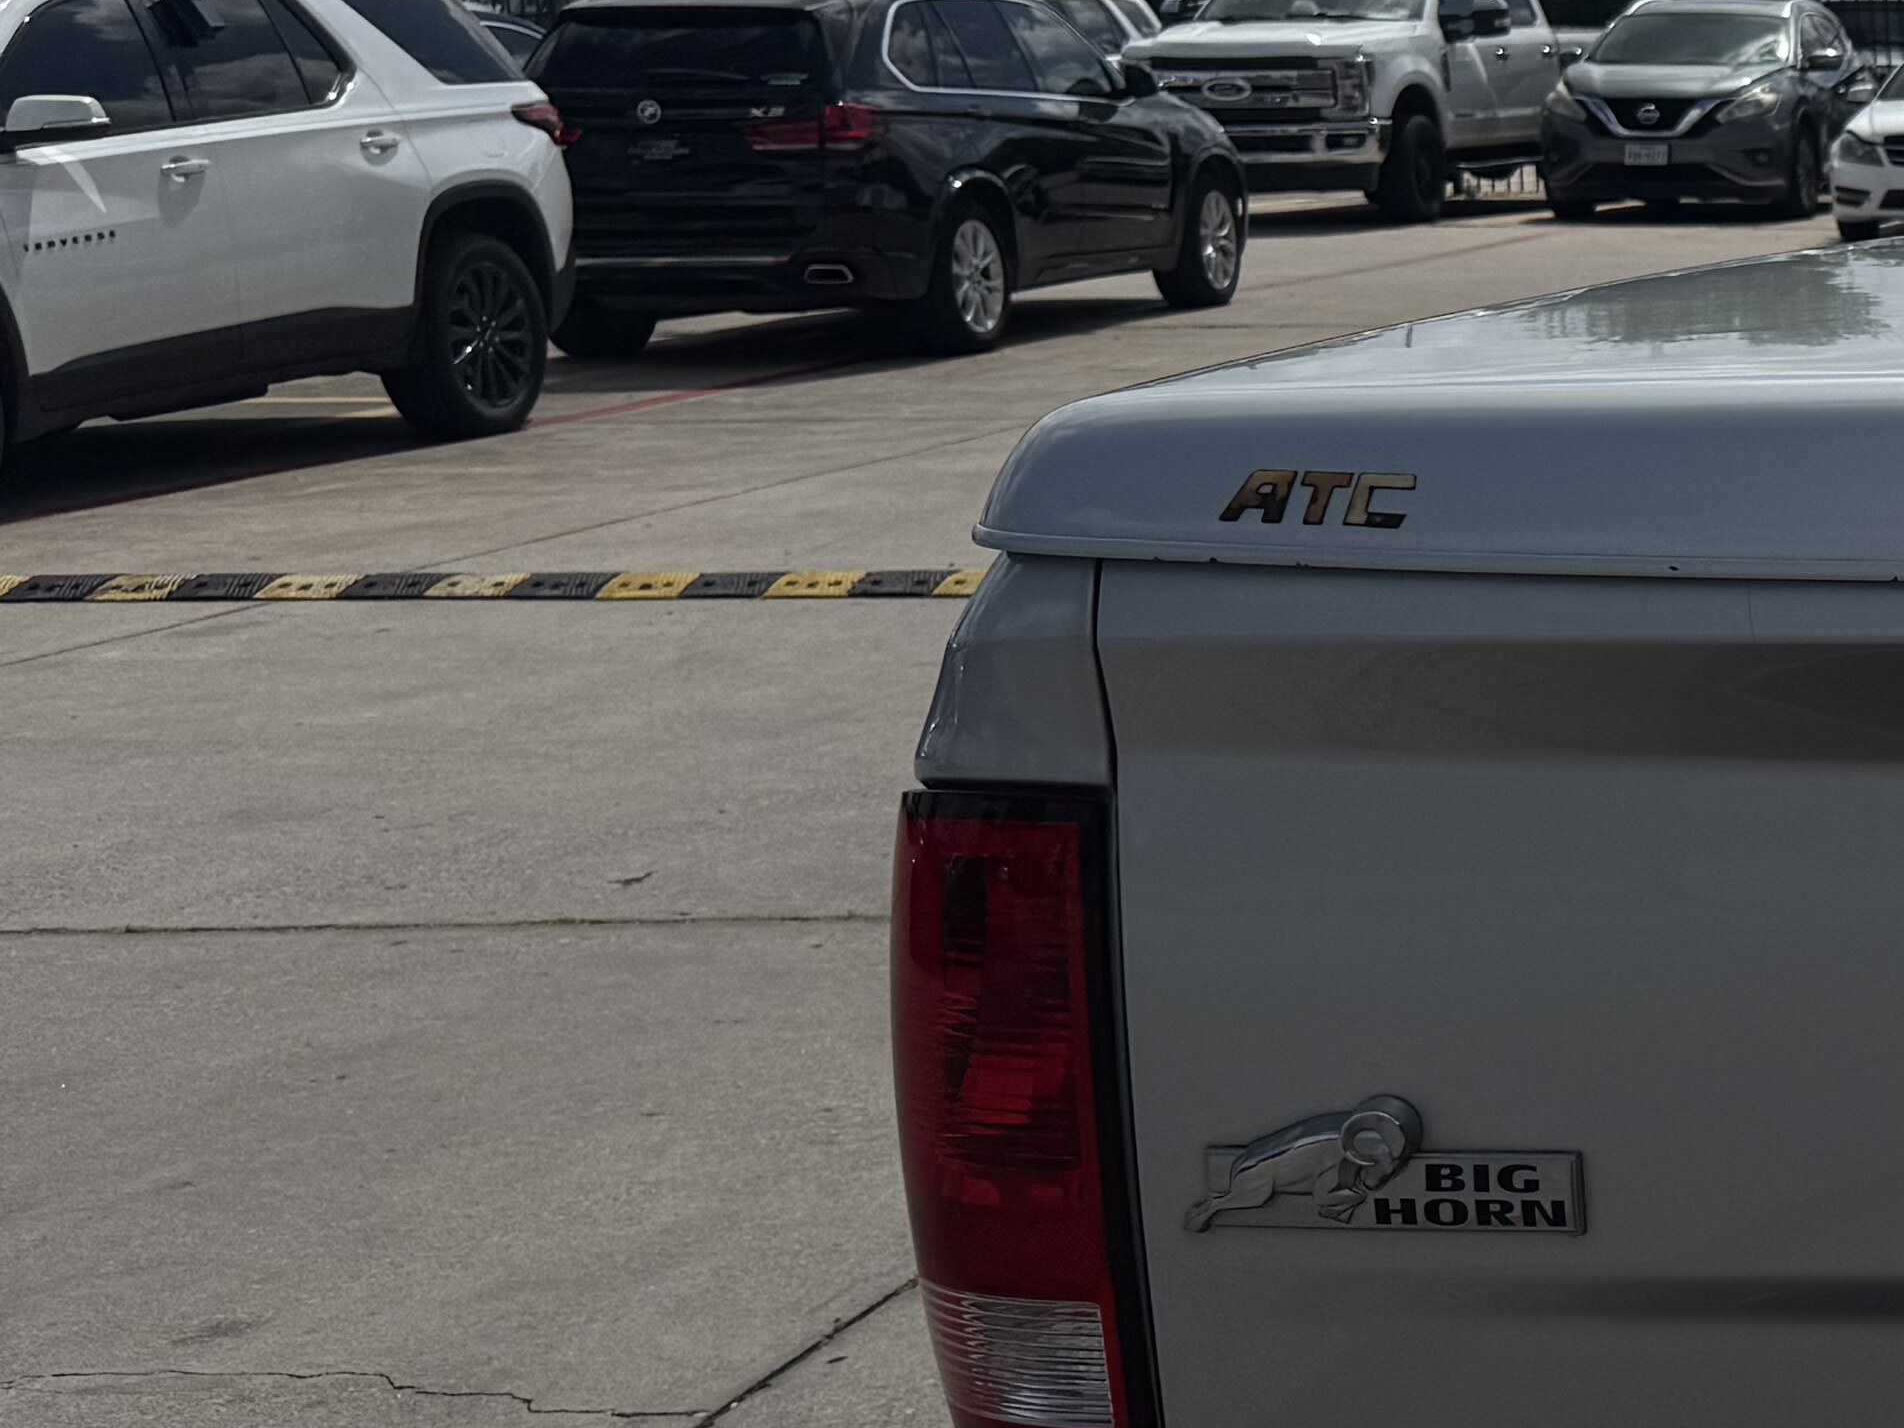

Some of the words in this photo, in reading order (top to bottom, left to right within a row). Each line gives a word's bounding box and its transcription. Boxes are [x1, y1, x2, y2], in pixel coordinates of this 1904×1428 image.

[1218, 469, 1418, 529] ATC
[1424, 1162, 1541, 1194] BIG
[1373, 1197, 1568, 1228] HORN
